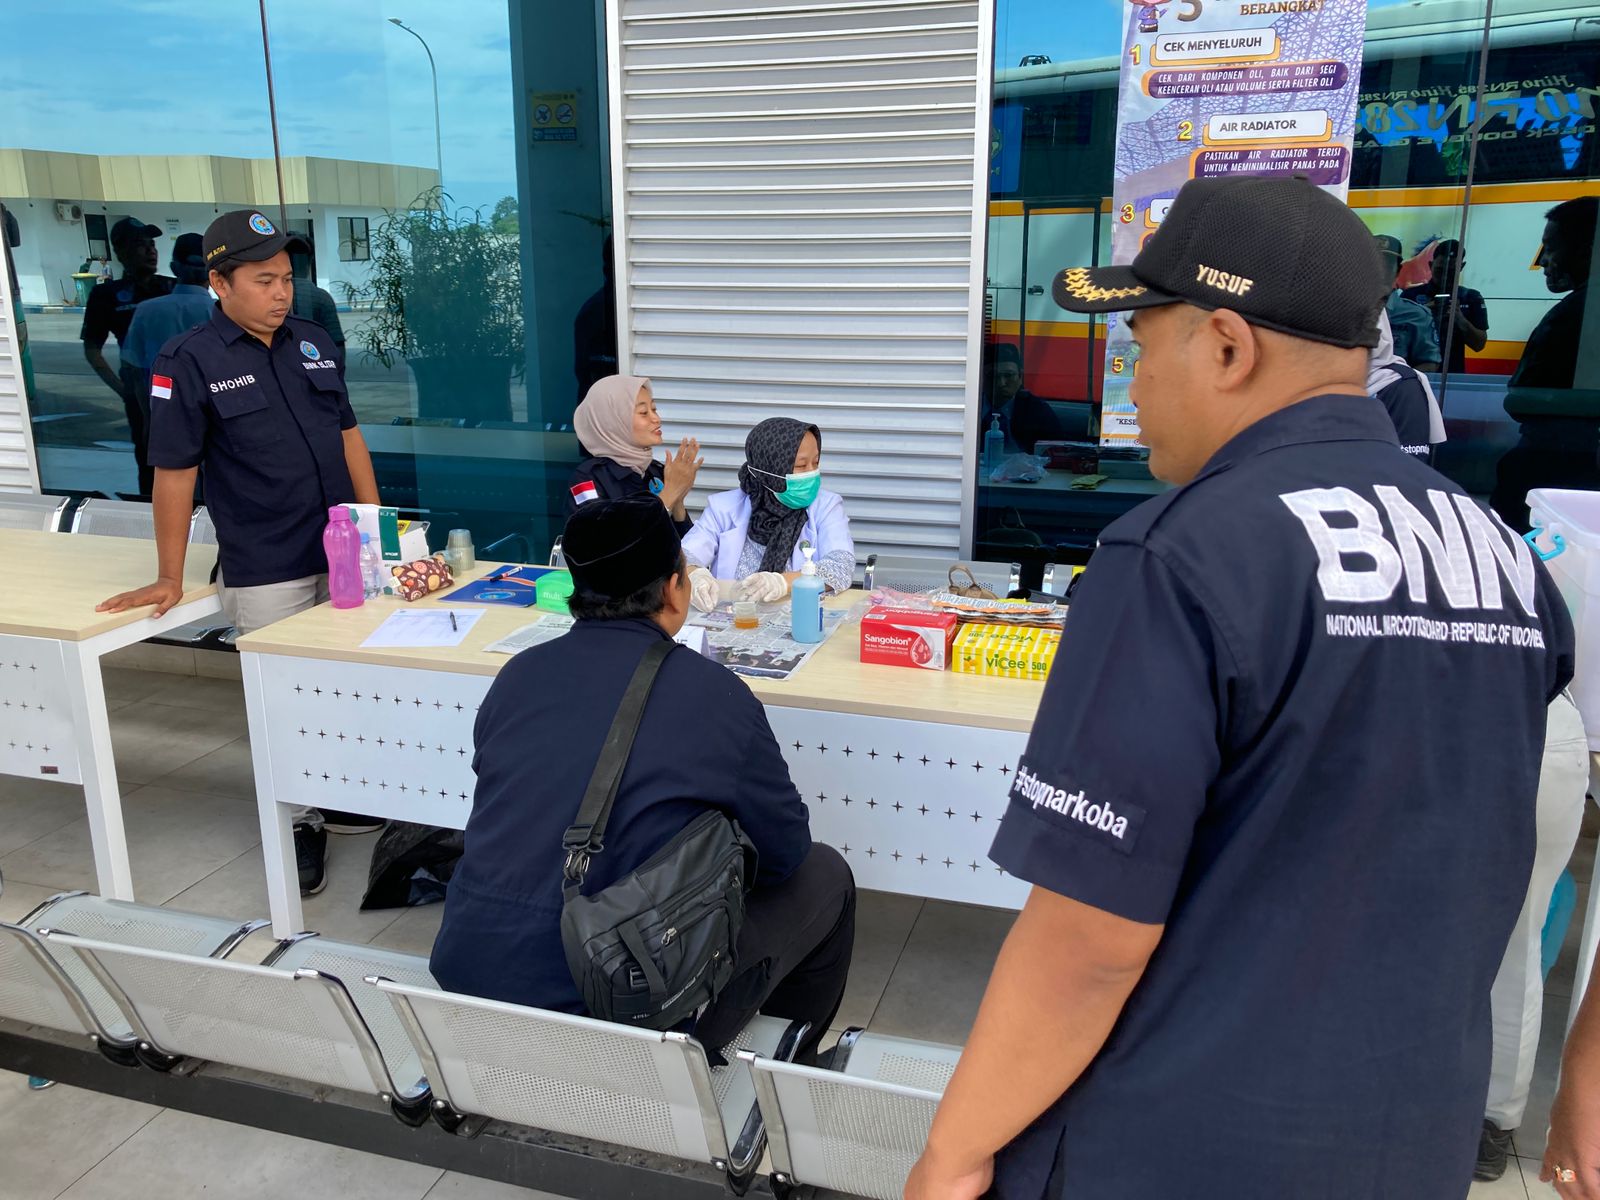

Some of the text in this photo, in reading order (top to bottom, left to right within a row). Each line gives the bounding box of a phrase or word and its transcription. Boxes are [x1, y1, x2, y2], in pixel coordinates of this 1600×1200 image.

[1163, 37, 1262, 52] CEK MENYELURUH
[1128, 44, 1141, 65] 1
[1158, 73, 1172, 83] CEK
[1178, 73, 1196, 82] DARI
[1201, 71, 1243, 81] KOMPONEN
[1271, 68, 1289, 77] BAIK
[1294, 66, 1314, 75] DARI
[1319, 64, 1337, 74] SEGI
[1157, 77, 1333, 95] KEENCERAN OLI ATAU VOLUME SERTA FILTER OLI
[1177, 121, 1194, 141] 2
[1220, 120, 1297, 132] AIR RADIATOR
[1204, 148, 1341, 161] PASTIKAN AIR RADIATOR TERISI
[1204, 160, 1339, 172] UNTUK MEMINIMALISIR PANAS PADA
[1120, 202, 1135, 224] 3
[1196, 264, 1254, 296] YUSUF
[1112, 356, 1124, 373] 5
[210, 374, 256, 393] SHOHIB
[1279, 484, 1538, 618] BNN
[1326, 614, 1382, 636] NATIONAL
[1451, 622, 1497, 644] REPUBLIC
[1499, 624, 1511, 645] OF
[1032, 662, 1047, 671] 500
[1014, 765, 1129, 839] #stopnarkoba
